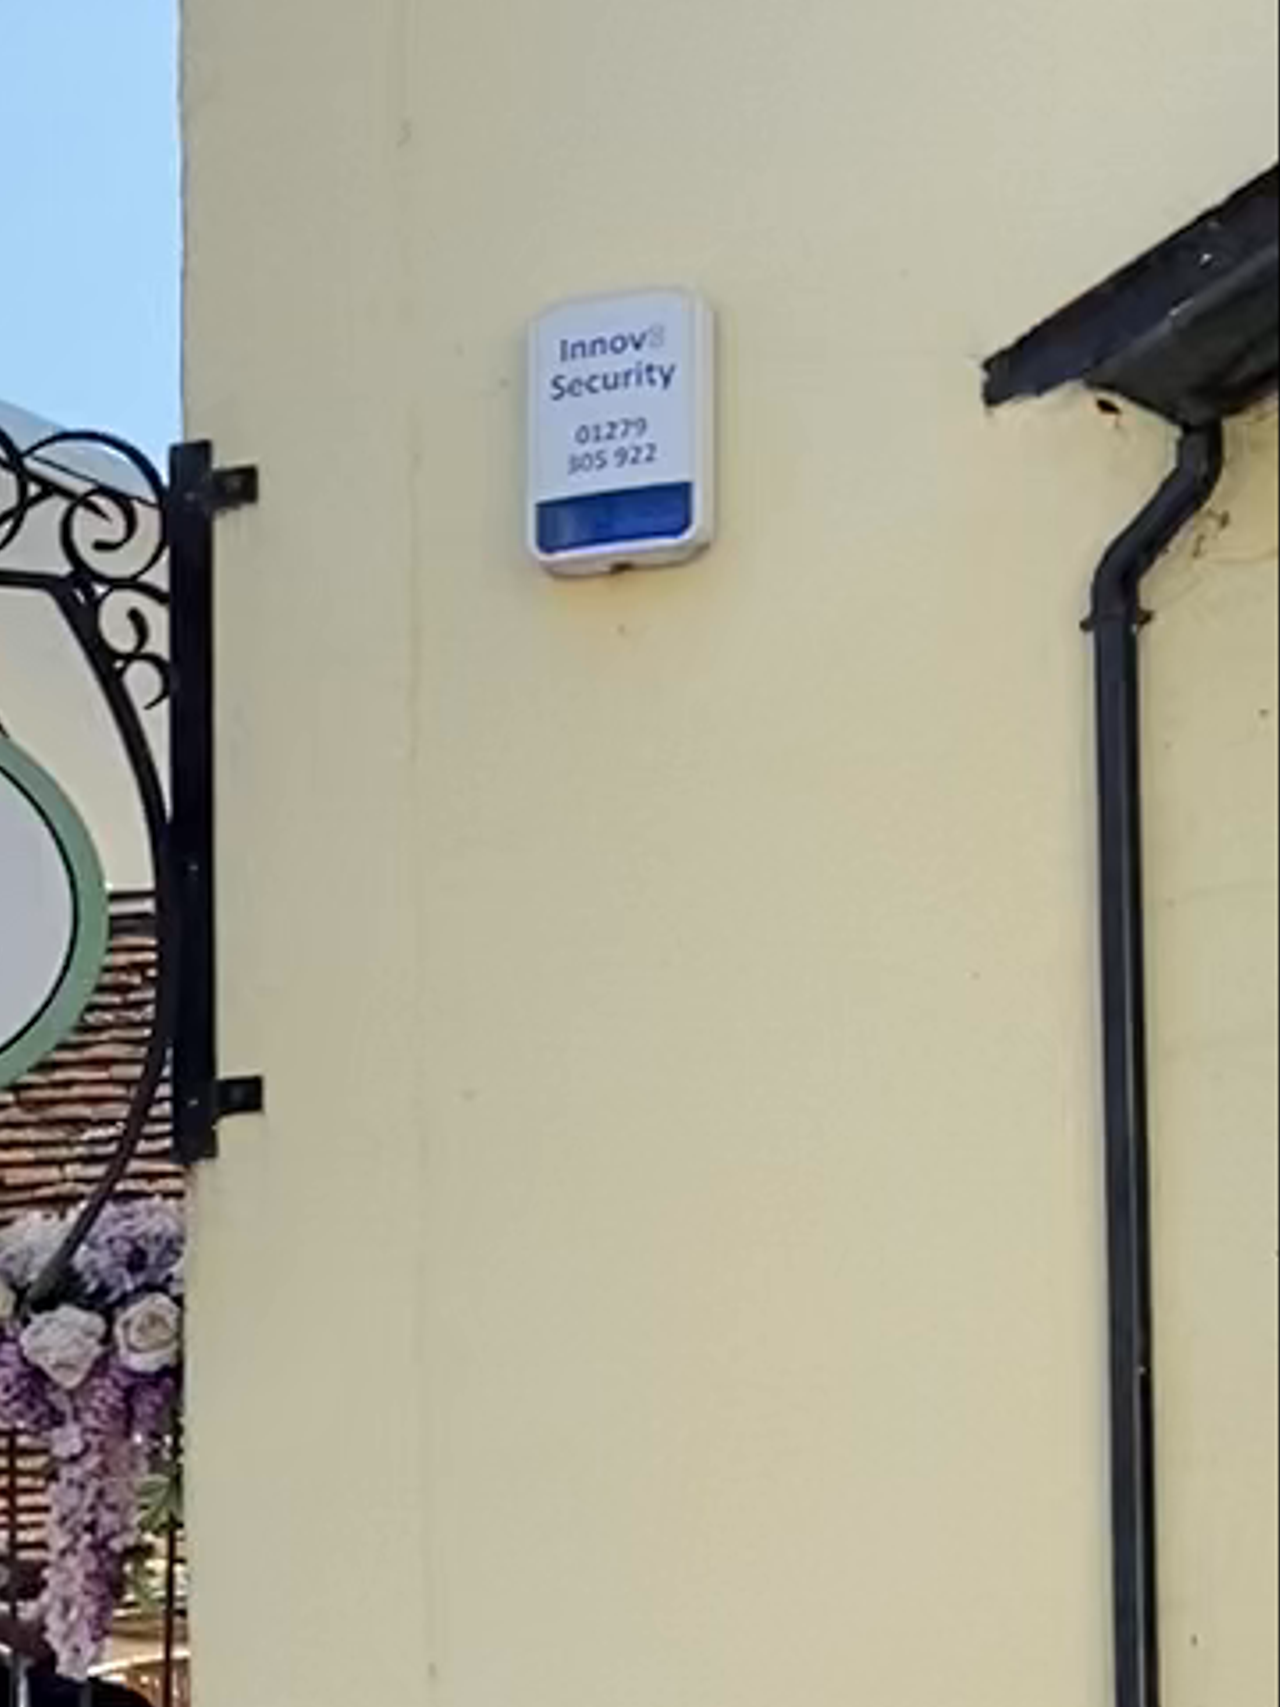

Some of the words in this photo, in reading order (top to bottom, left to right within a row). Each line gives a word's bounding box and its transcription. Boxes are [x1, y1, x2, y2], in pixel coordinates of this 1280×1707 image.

[559, 323, 665, 362] Innov8
[549, 361, 676, 401] Security
[574, 417, 648, 445] 01279
[613, 442, 658, 469] 922
